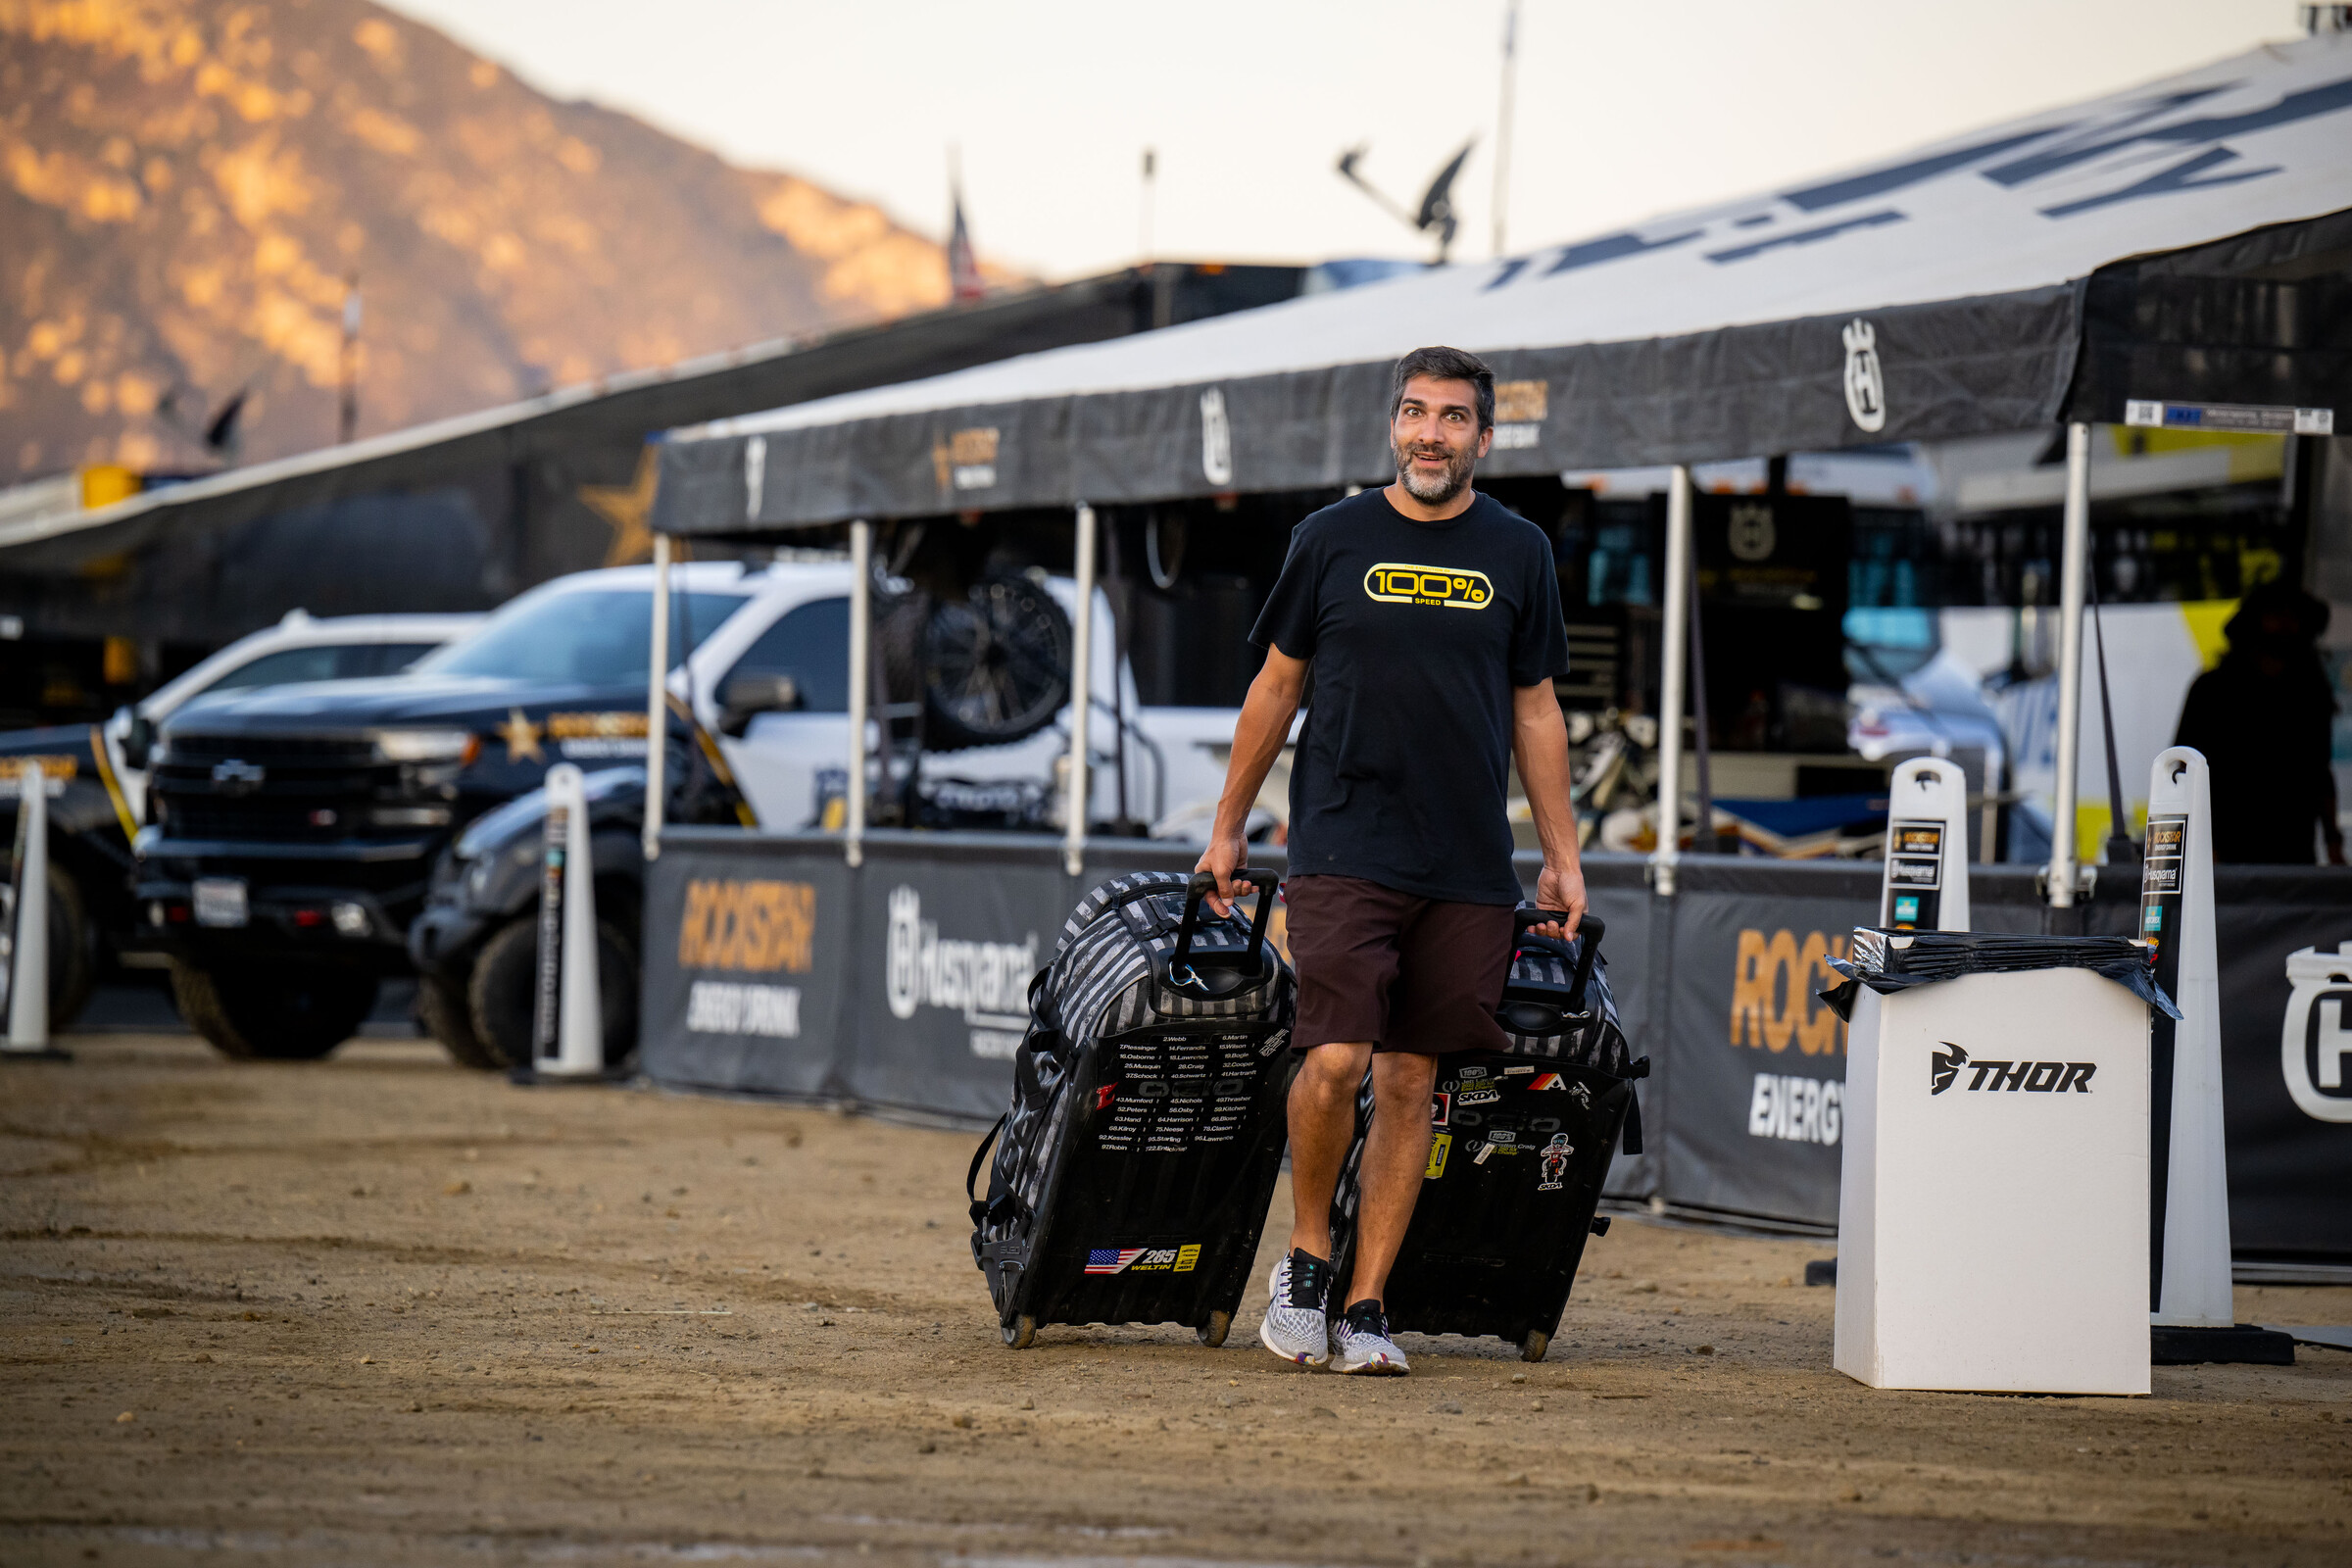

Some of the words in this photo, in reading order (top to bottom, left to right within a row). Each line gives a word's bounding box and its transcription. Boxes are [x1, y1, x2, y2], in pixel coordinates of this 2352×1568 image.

[1375, 571, 1485, 602] 100%
[1415, 597, 1441, 606] SPEED
[1967, 1060, 2098, 1094] THOR
[1748, 1073, 1846, 1147] ENERG
[1142, 1249, 1178, 1264] 285
